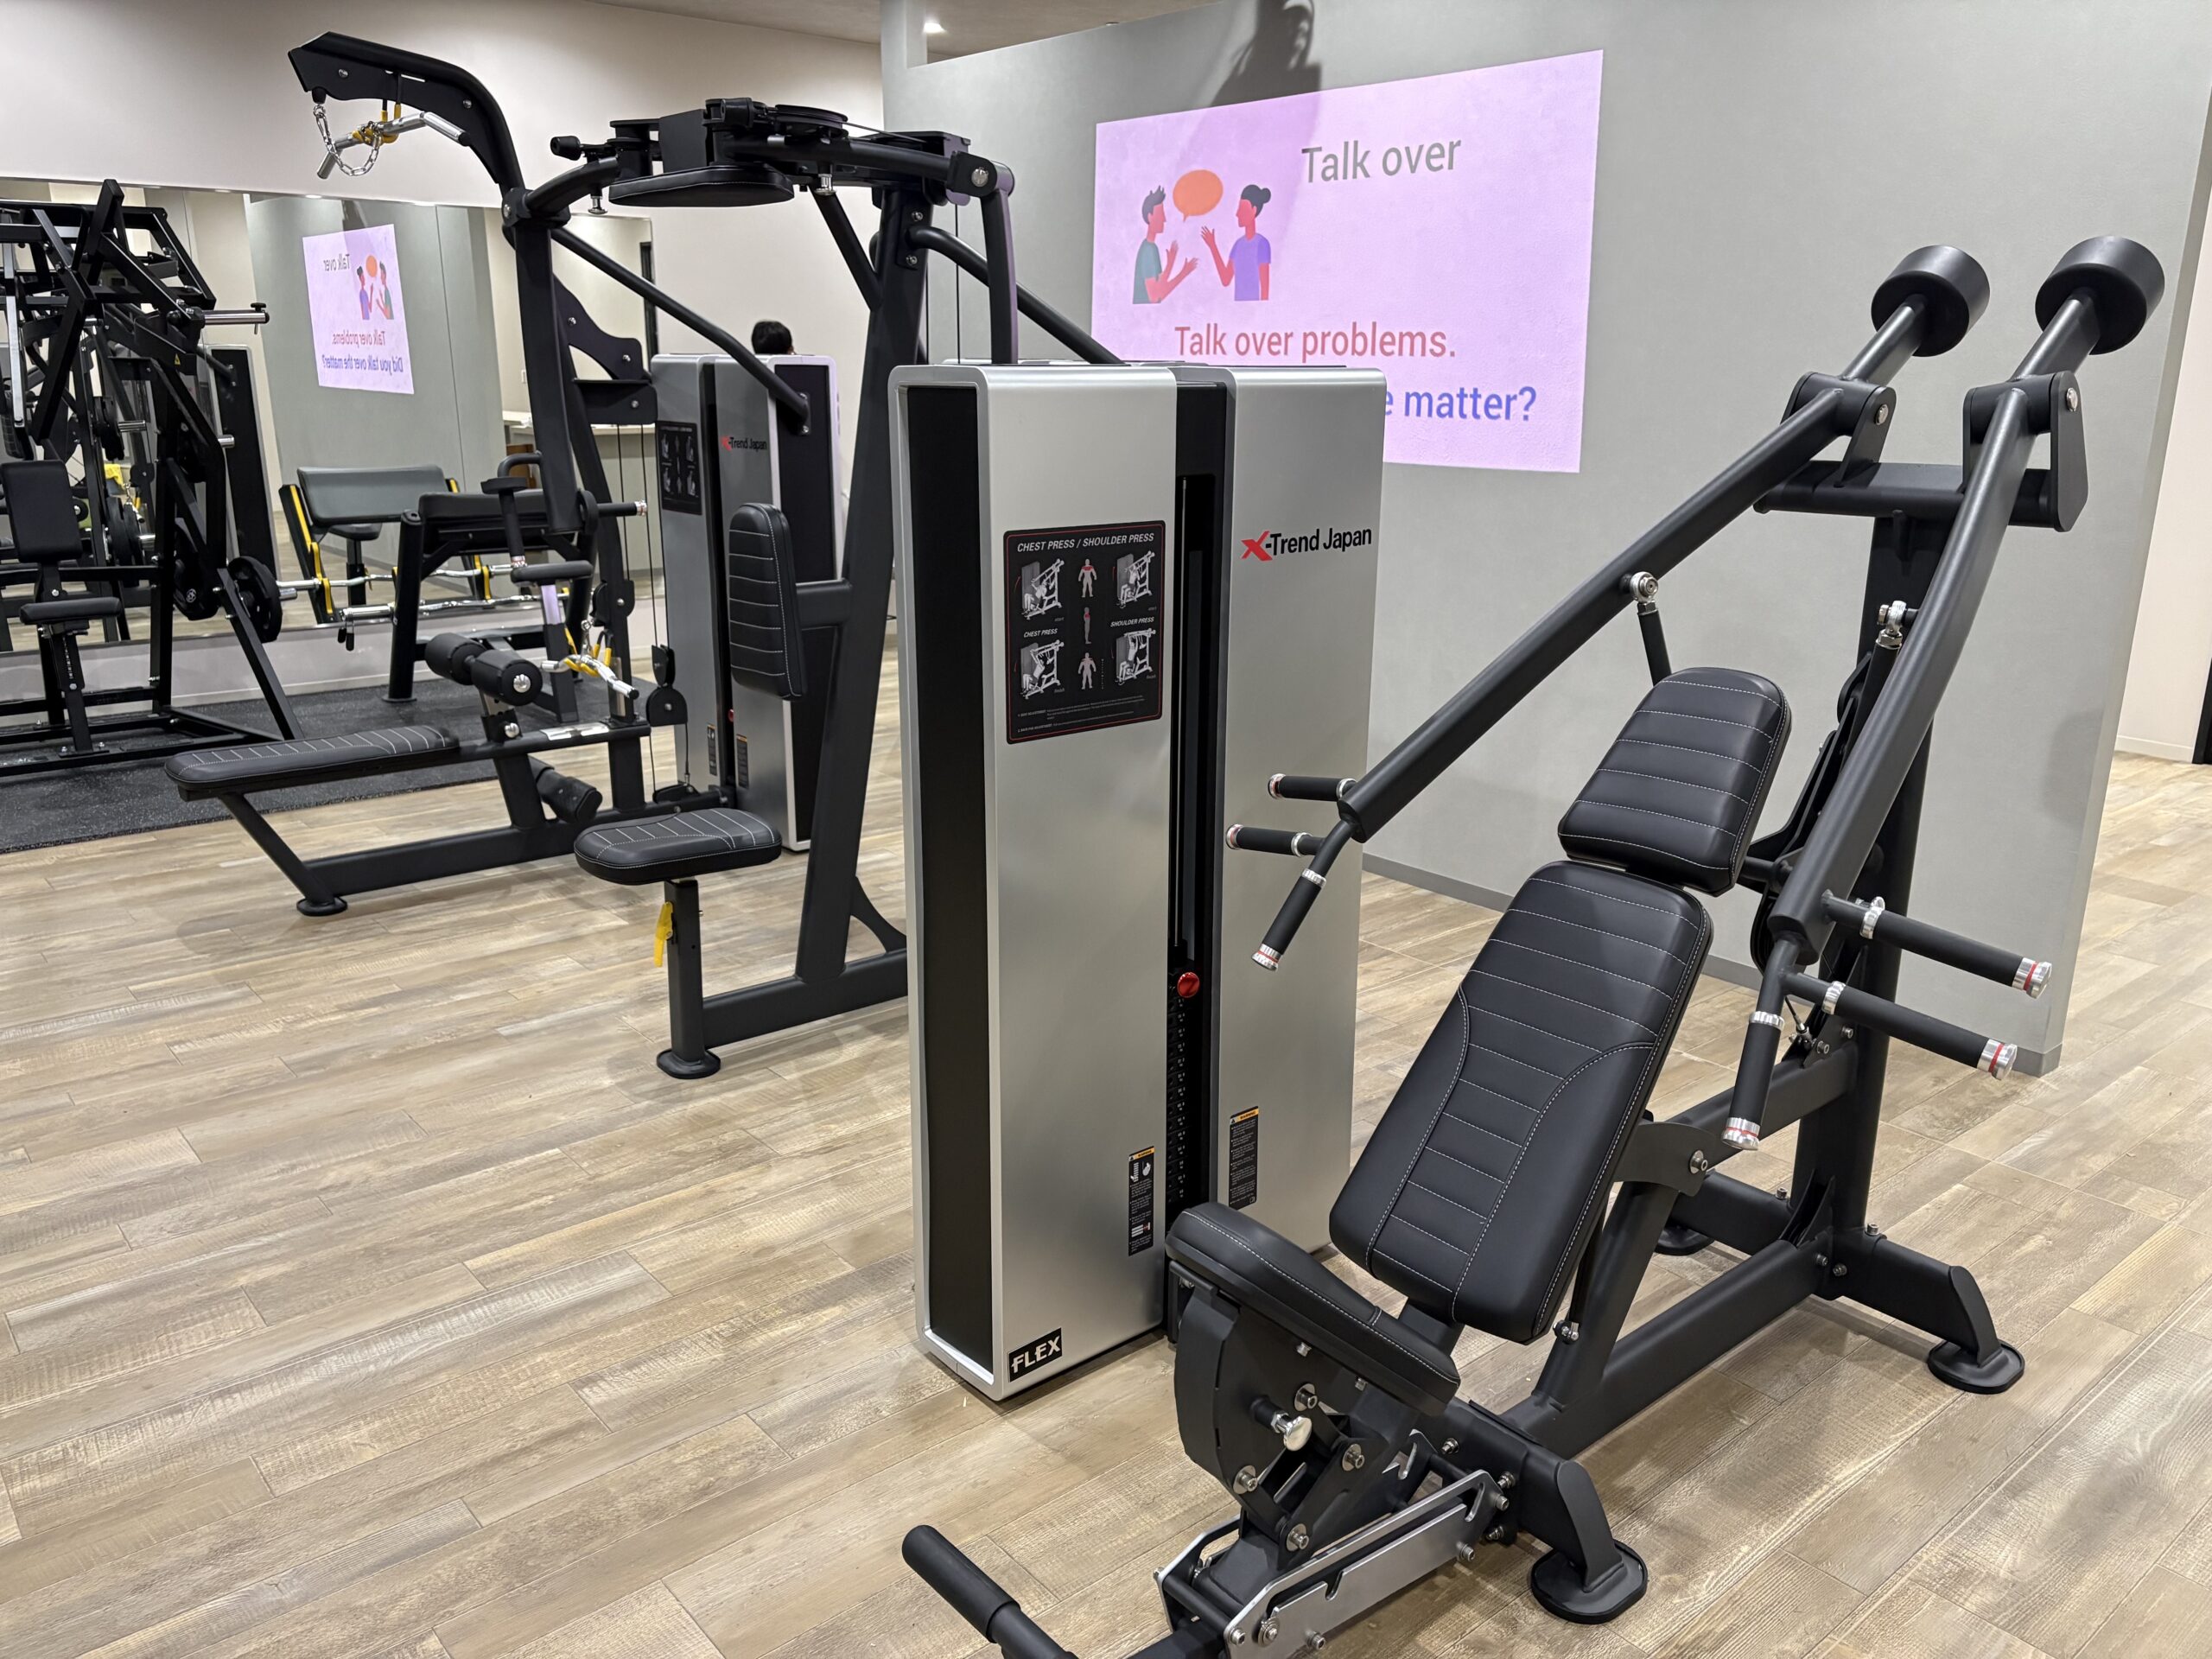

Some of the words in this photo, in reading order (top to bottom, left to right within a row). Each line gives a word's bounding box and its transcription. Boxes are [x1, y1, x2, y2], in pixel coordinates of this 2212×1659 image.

[1301, 140, 1370, 183] Talk
[1382, 139, 1462, 176] over
[1174, 323, 1227, 356] Talk
[1235, 332, 1294, 356] over
[1302, 321, 1455, 363] problems.
[1404, 386, 1537, 421] matter?
[749, 438, 768, 452] Japan
[1017, 541, 1046, 552] CHEST
[1047, 538, 1075, 550] PRESS
[1077, 538, 1082, 549] /
[1083, 535, 1127, 547] SHOULDER
[1128, 533, 1155, 543] PRESS
[1240, 528, 1320, 562] X-Trend
[1323, 527, 1372, 552] Japan
[1110, 619, 1139, 628] SHOULDER
[1011, 1336, 1061, 1374] FLEX
